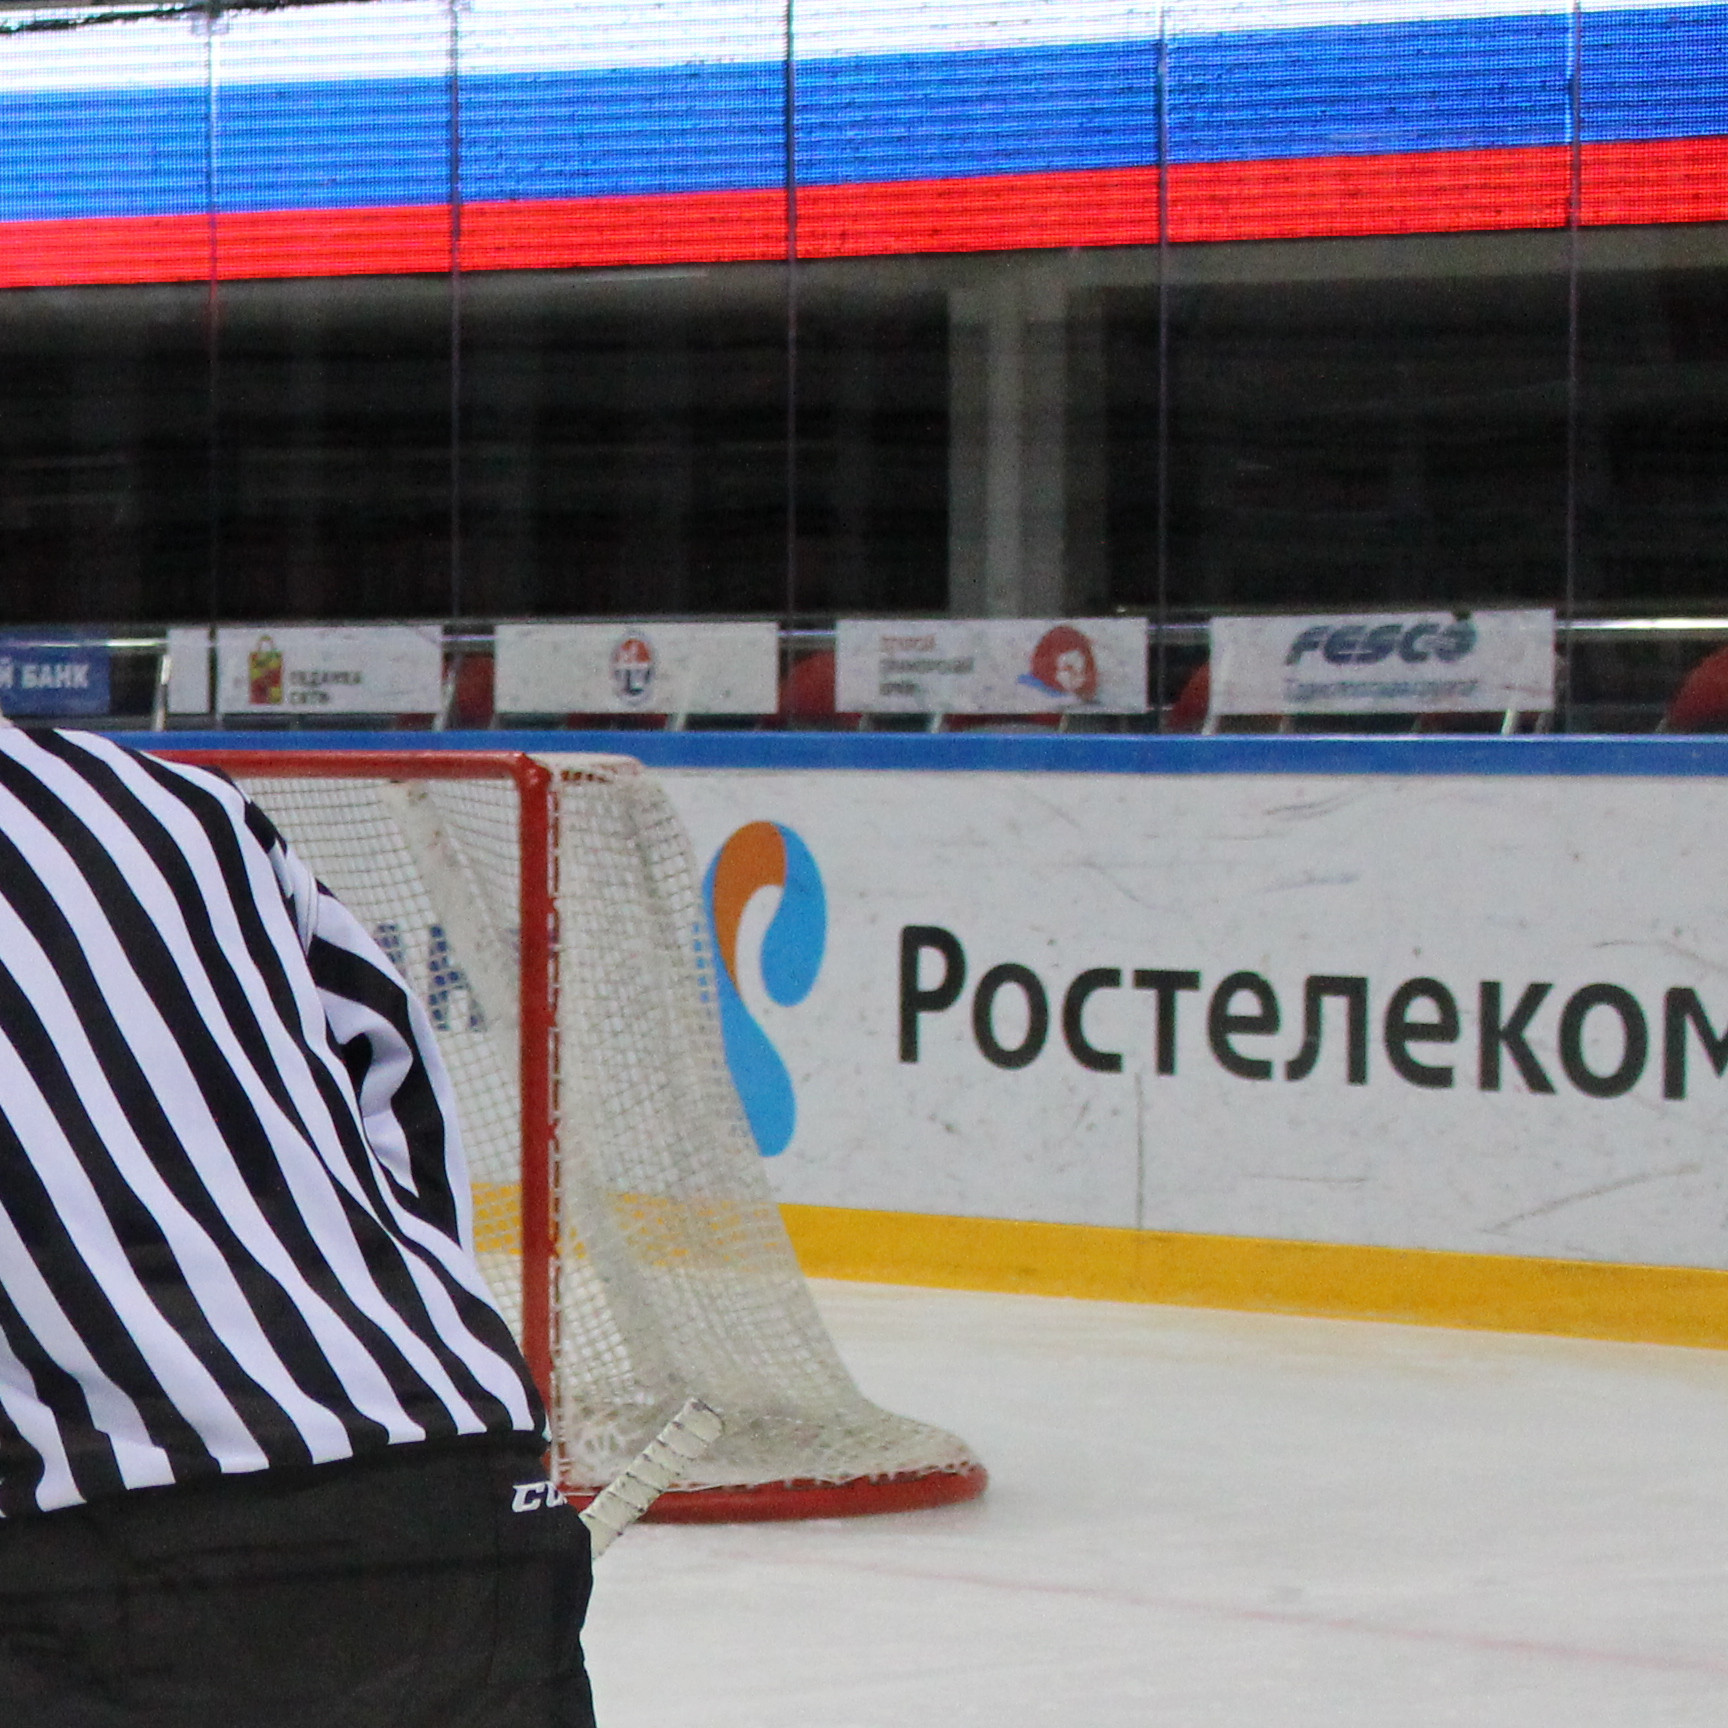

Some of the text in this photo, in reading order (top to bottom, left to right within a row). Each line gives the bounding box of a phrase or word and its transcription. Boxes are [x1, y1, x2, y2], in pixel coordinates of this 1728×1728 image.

[1285, 622, 1478, 666] FESCO
[20, 662, 90, 690] БАНК
[898, 924, 1728, 1102] Ростелеком
